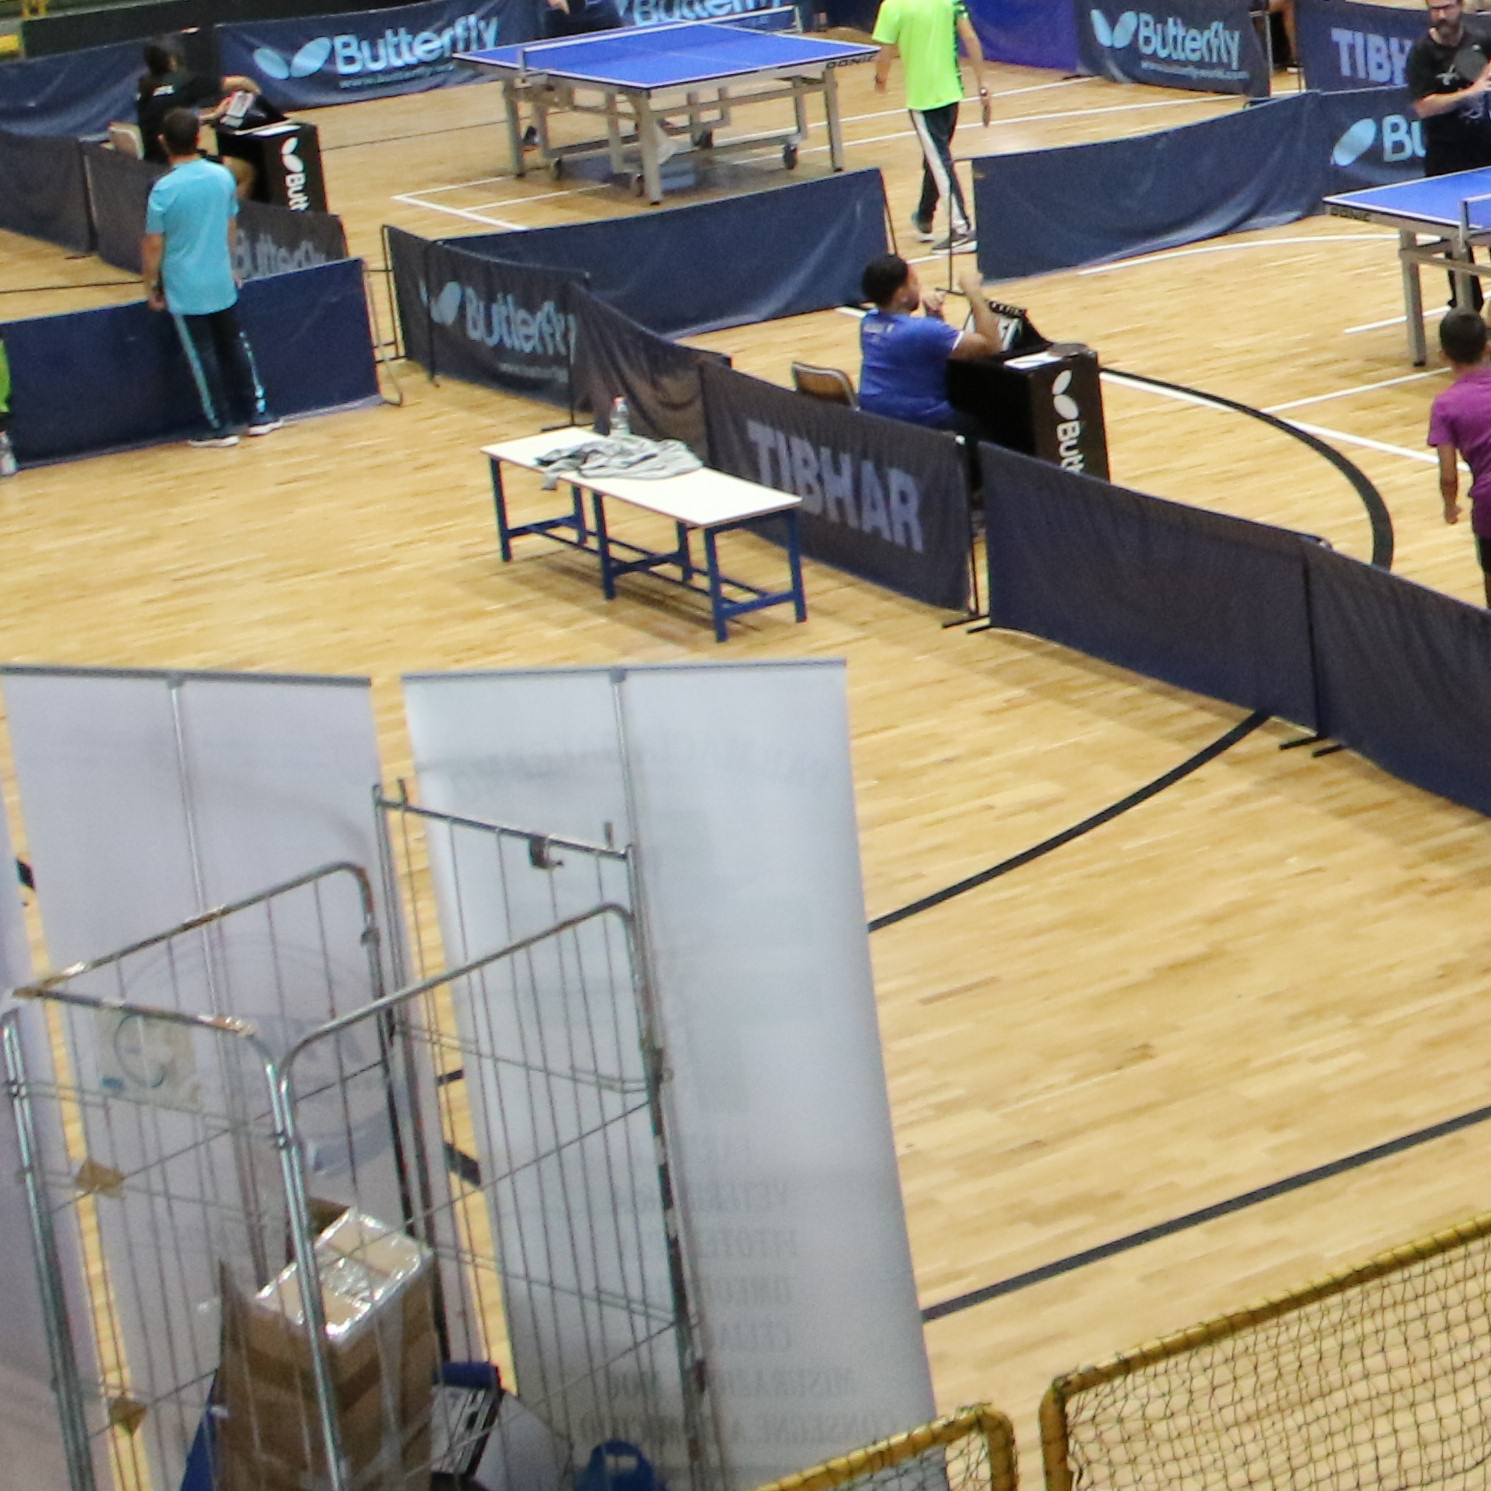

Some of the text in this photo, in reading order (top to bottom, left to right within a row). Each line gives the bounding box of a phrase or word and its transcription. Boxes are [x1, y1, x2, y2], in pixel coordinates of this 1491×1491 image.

[335, 14, 500, 76] Butterfly
[1137, 9, 1241, 71] Butterfly
[463, 287, 577, 363] Butterfly
[746, 419, 924, 554] TIBHAR
